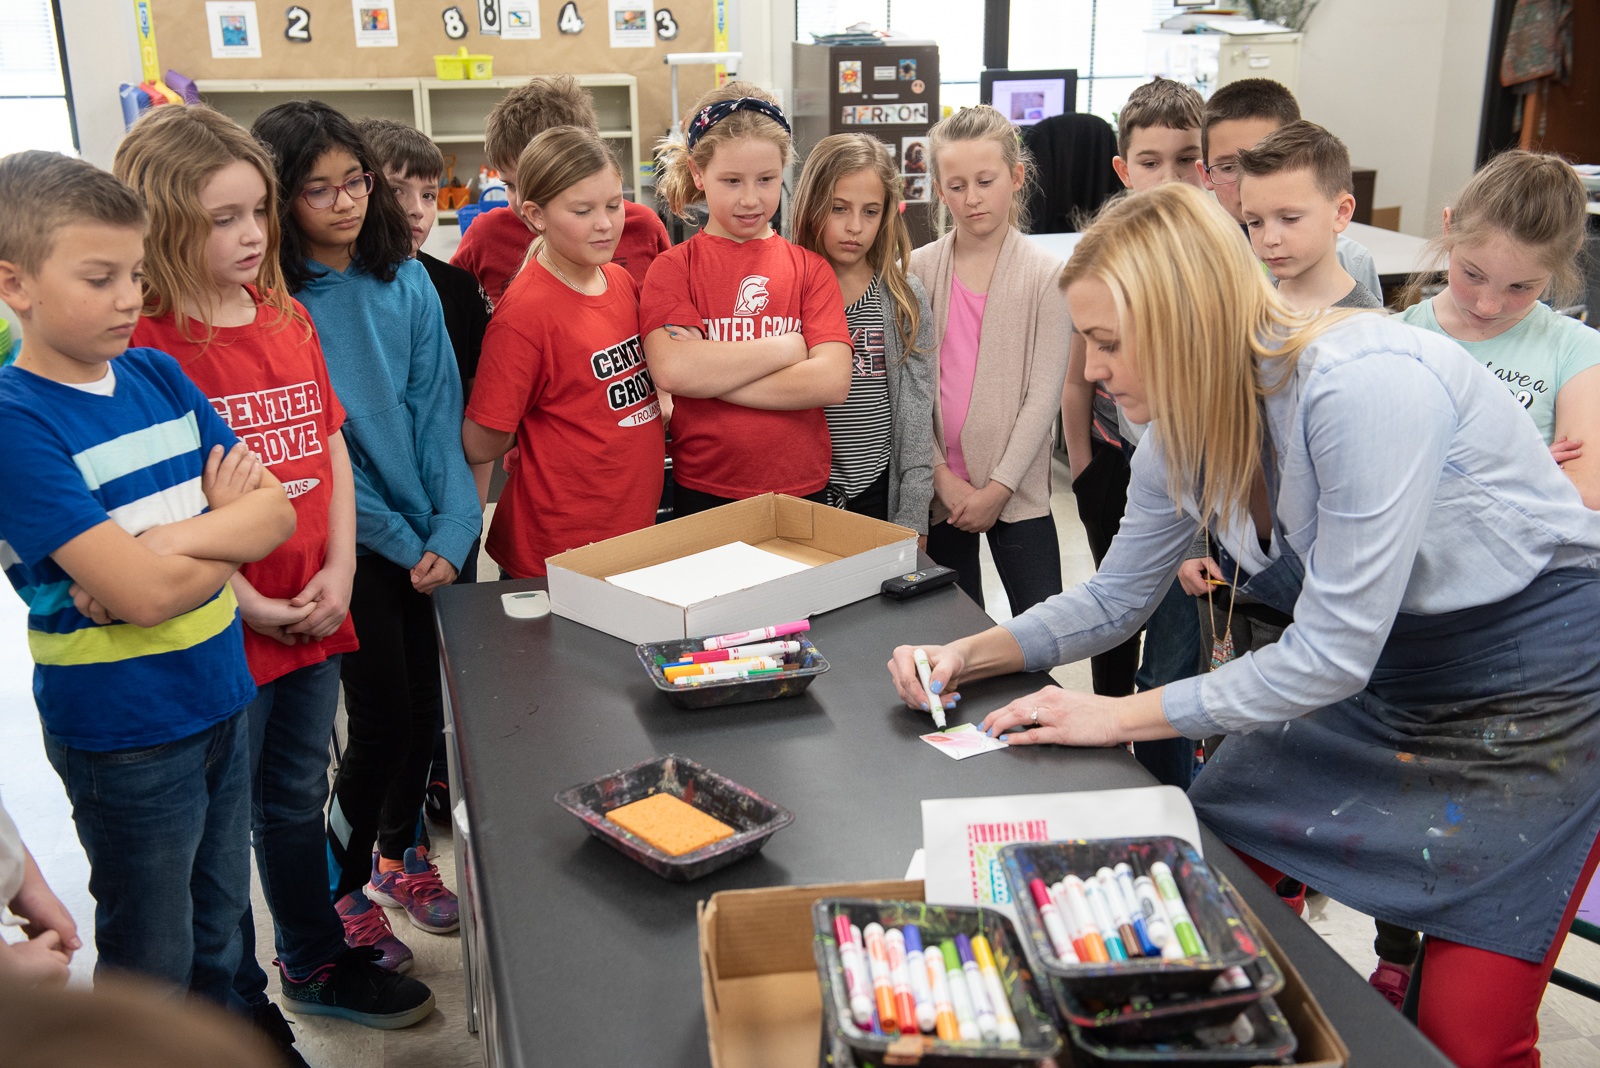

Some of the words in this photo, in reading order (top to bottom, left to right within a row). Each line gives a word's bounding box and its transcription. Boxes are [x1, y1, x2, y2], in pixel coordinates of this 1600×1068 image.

[286, 6, 310, 41] 2
[443, 7, 466, 39] 8
[559, 2, 583, 33] 4
[655, 10, 677, 39] 3
[236, 420, 323, 467] ROVE
